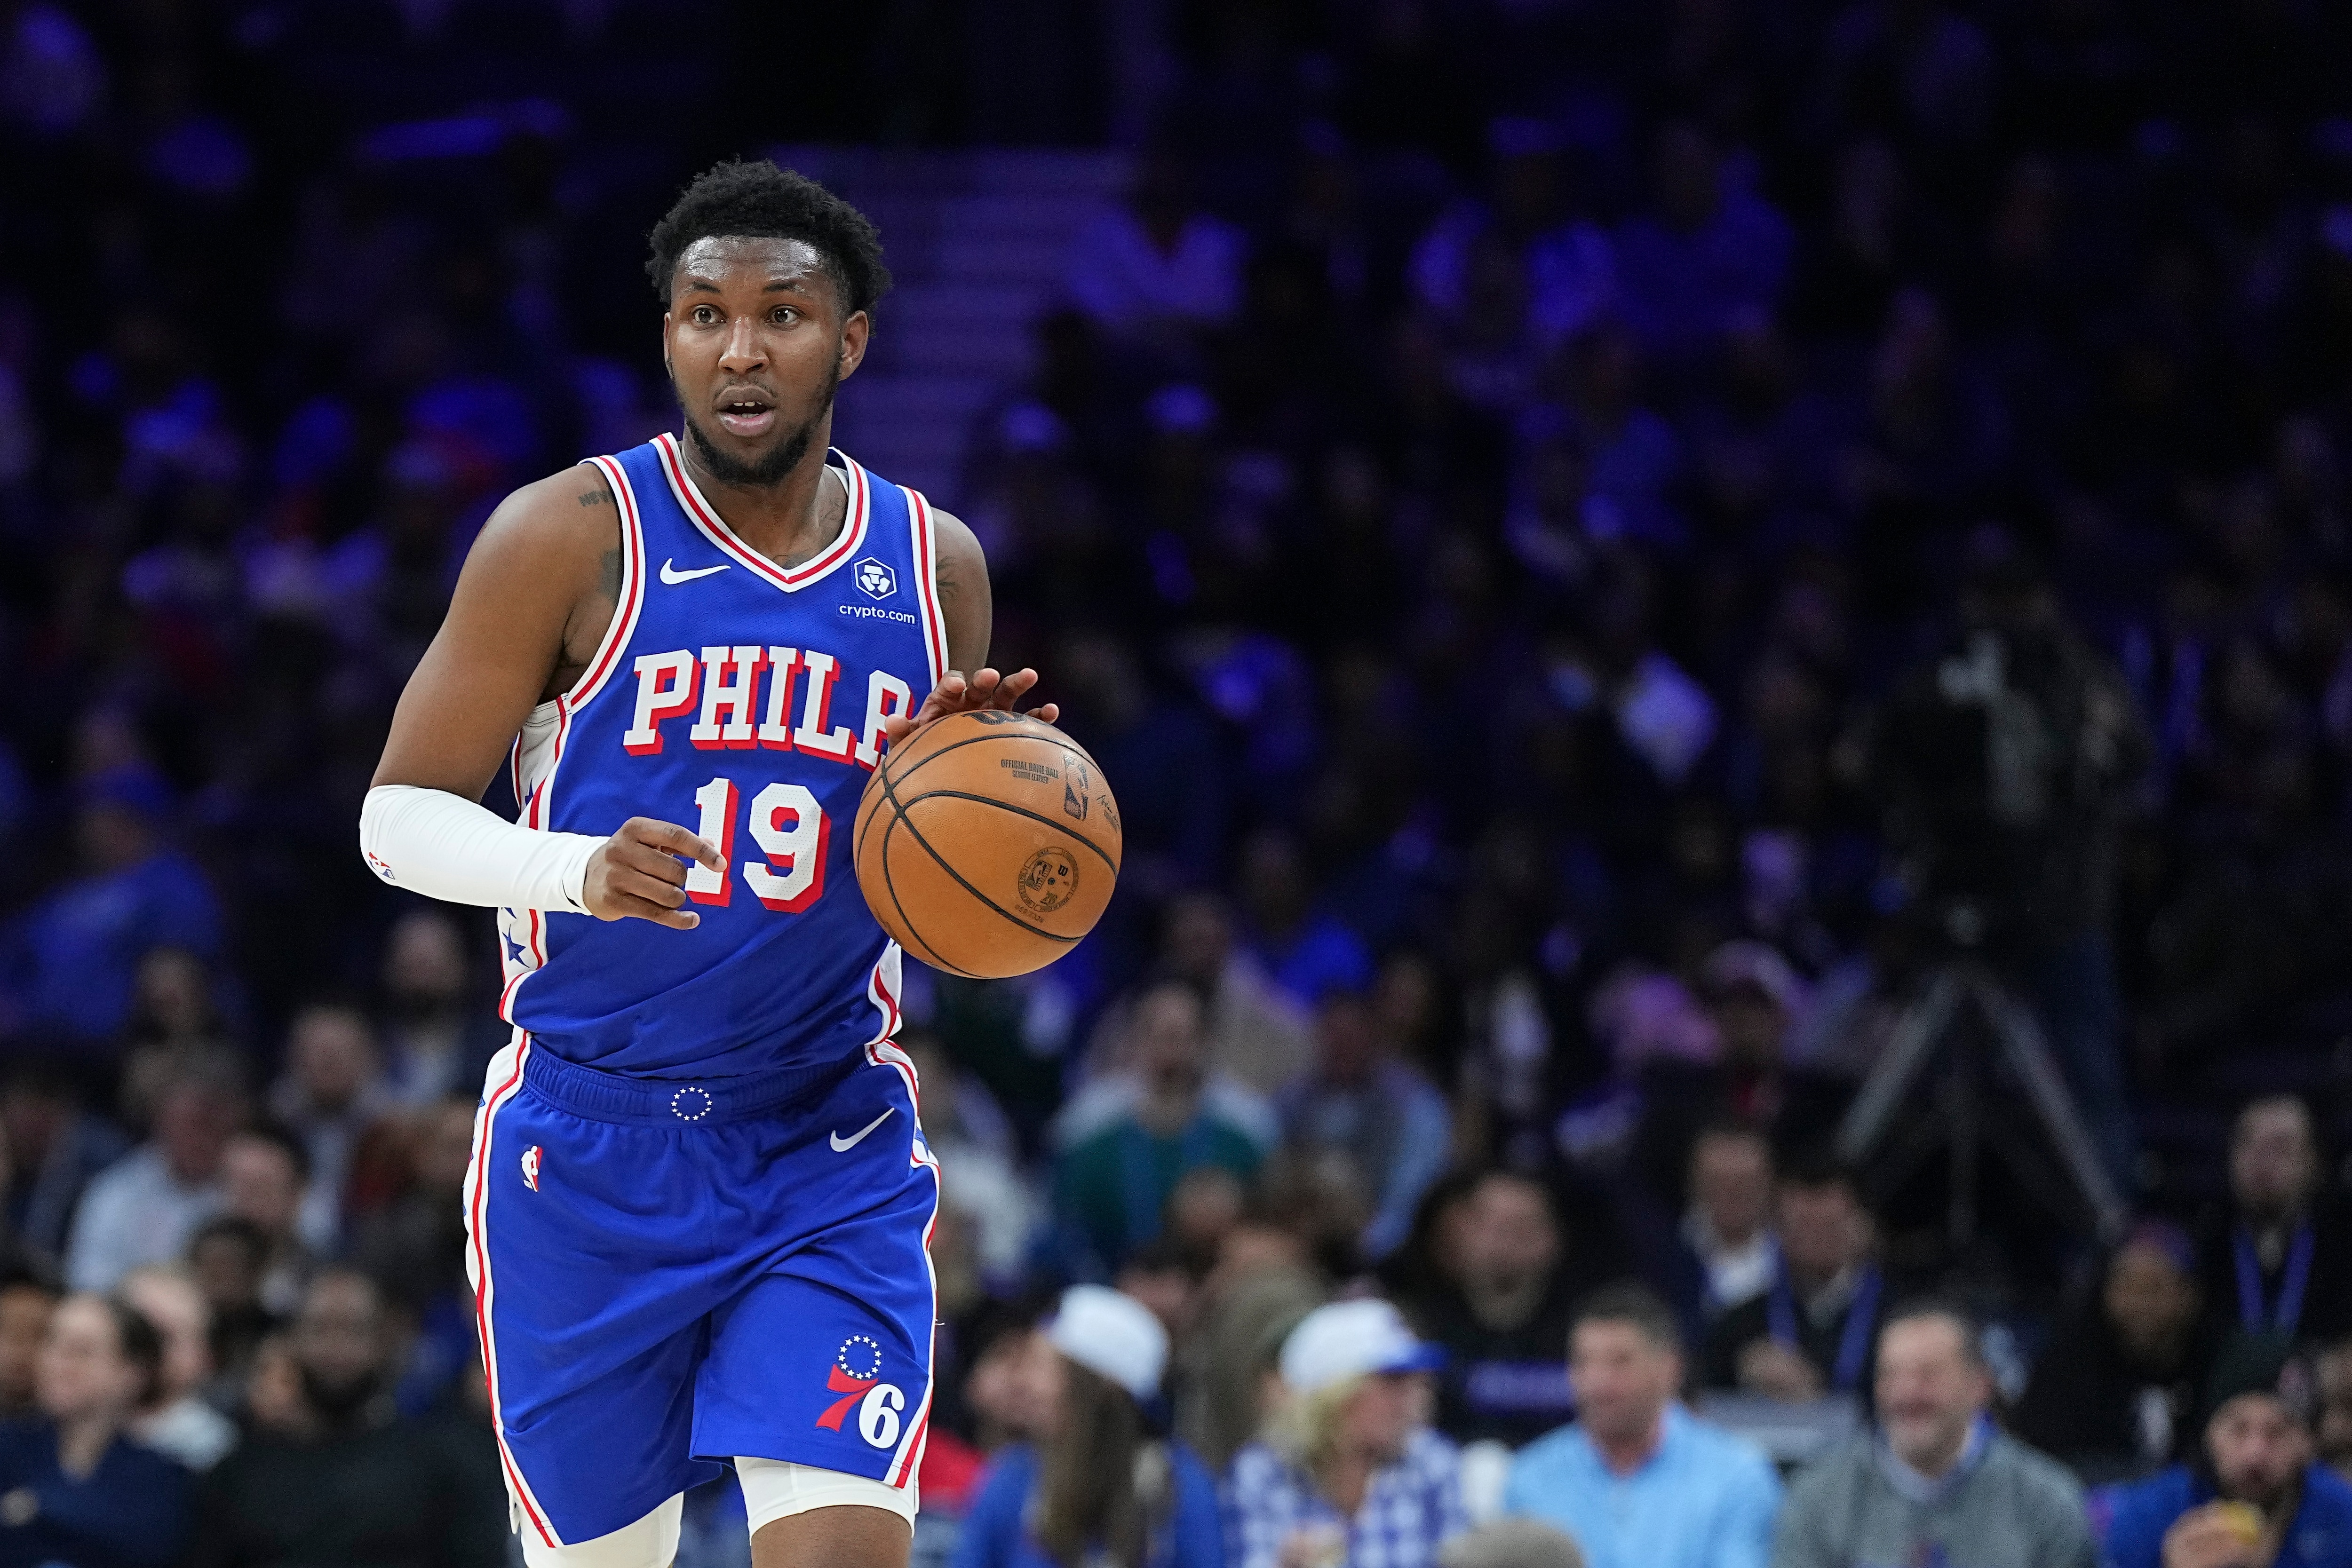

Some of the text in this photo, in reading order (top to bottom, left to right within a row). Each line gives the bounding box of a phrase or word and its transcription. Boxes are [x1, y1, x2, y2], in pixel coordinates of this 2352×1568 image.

[839, 605, 915, 624] crypto.com
[684, 777, 831, 913] 19
[815, 1364, 905, 1449] 76
